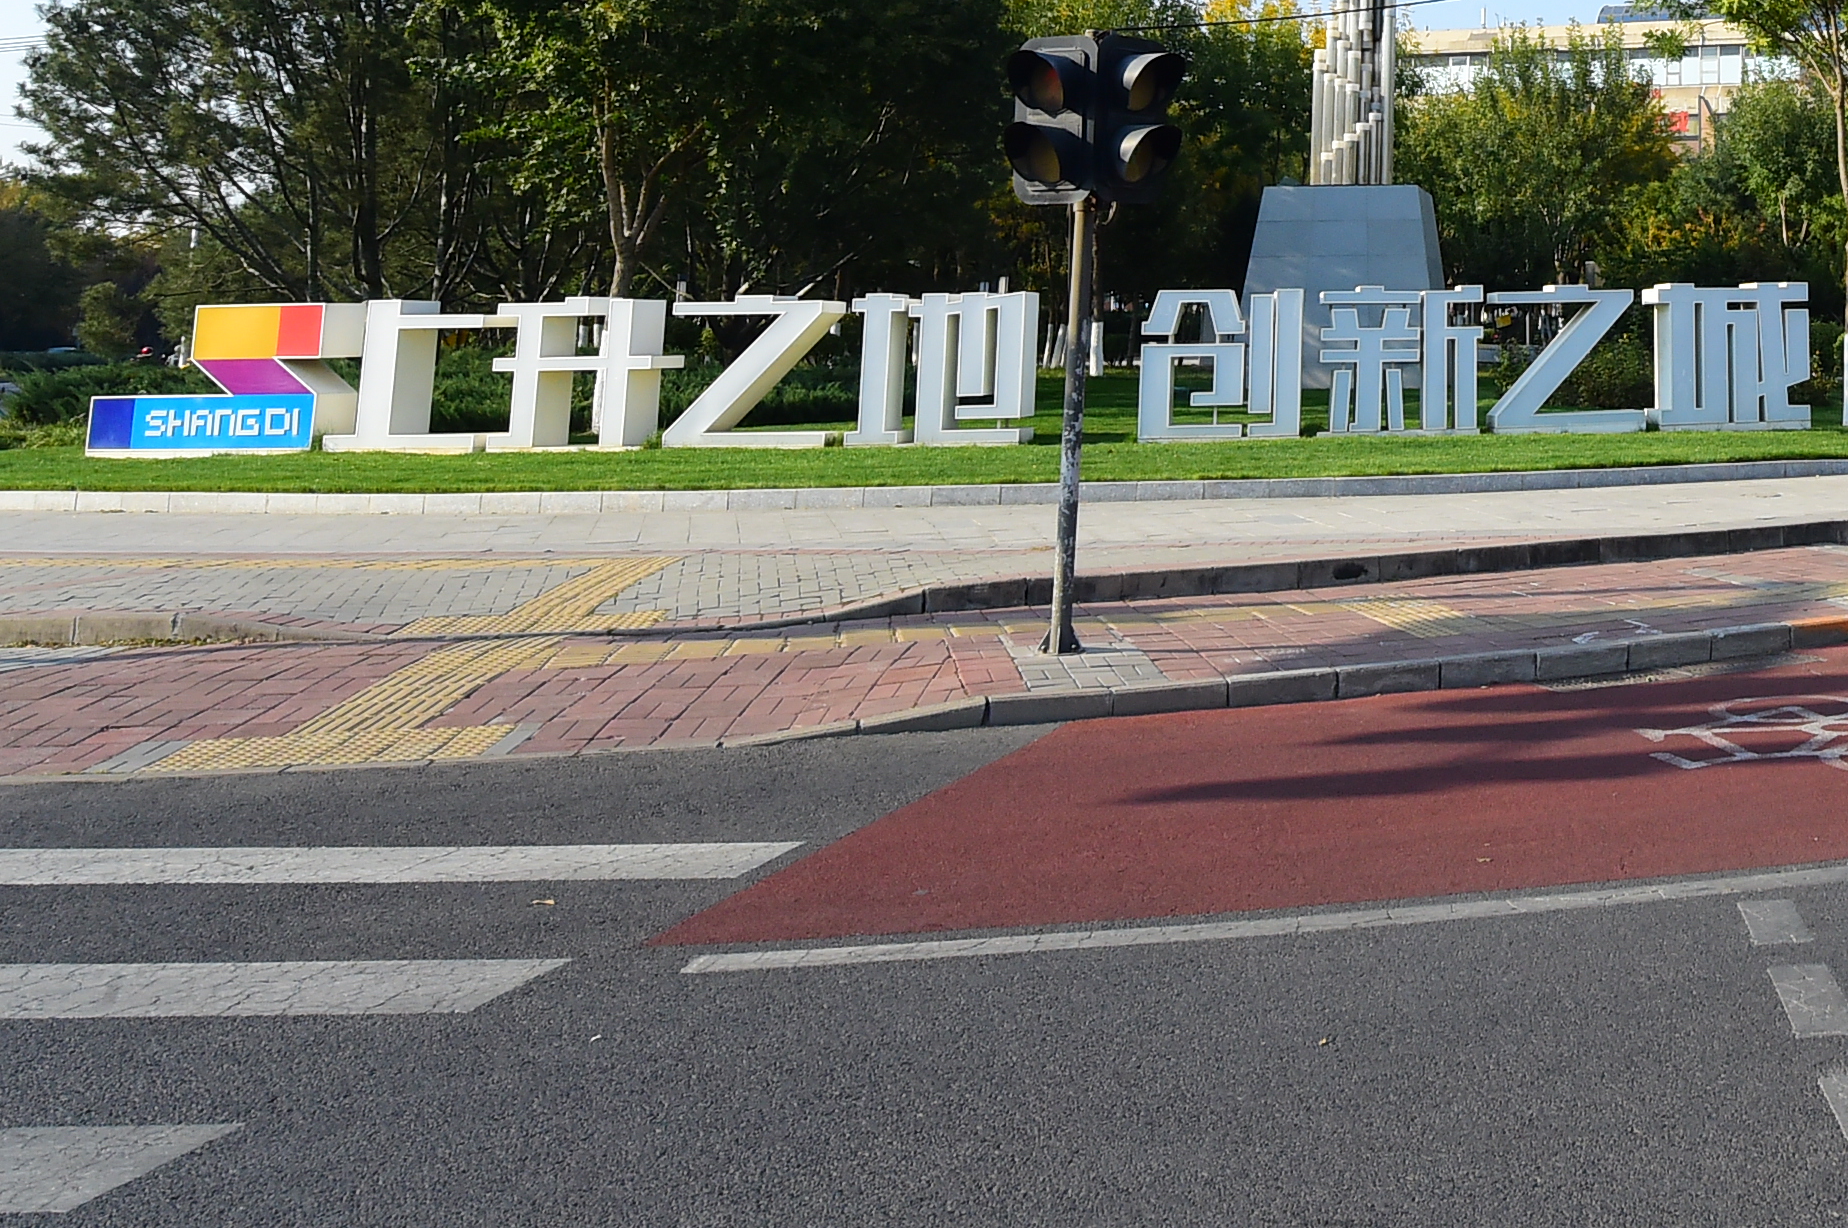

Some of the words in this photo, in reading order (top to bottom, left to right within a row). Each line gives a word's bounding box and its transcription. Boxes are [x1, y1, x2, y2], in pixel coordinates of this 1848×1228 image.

[322, 292, 1041, 452] 上升之地
[1137, 284, 1811, 442] 创新之城
